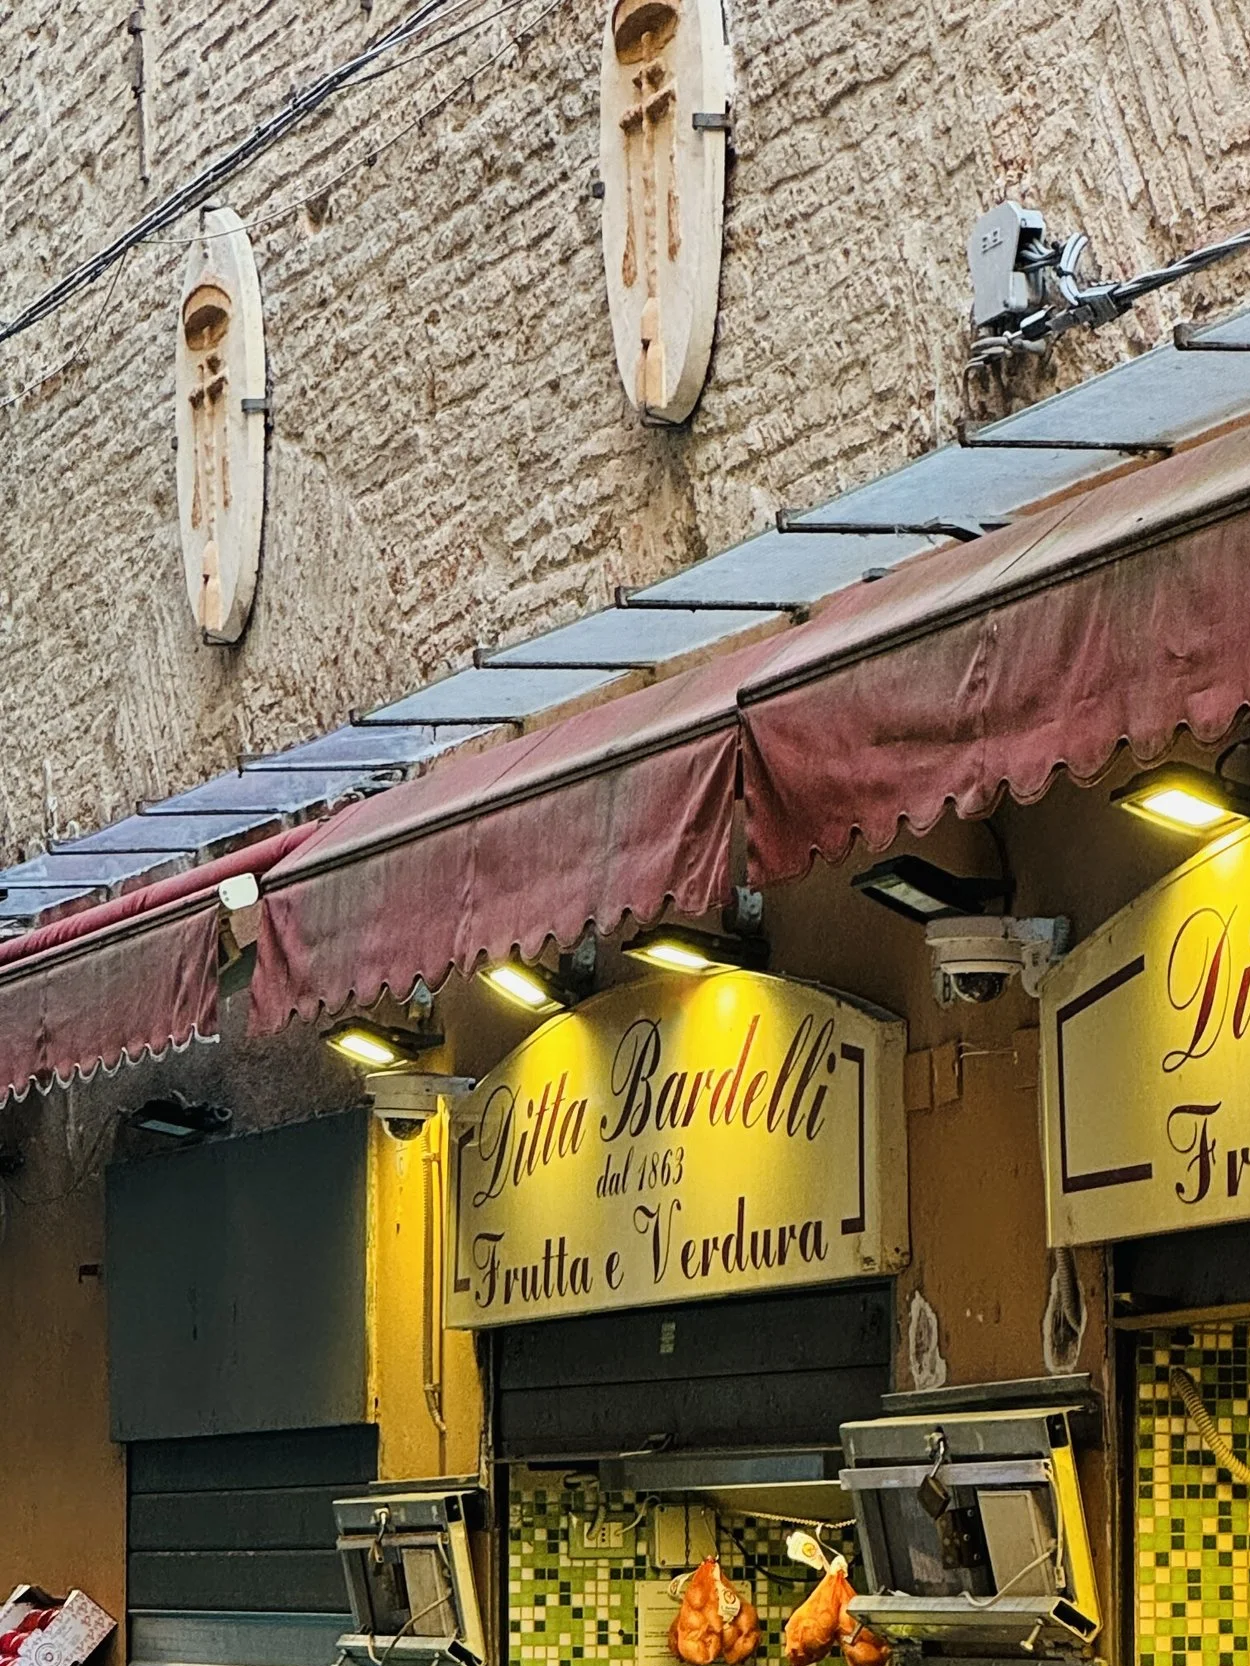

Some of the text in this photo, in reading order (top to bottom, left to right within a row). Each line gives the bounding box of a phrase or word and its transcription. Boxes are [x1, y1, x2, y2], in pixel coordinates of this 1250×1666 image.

[474, 1013, 836, 1207] Ditta Bardelli
[597, 1145, 684, 1198] dal 1863
[473, 1197, 828, 1308] Frutta e Verdura
